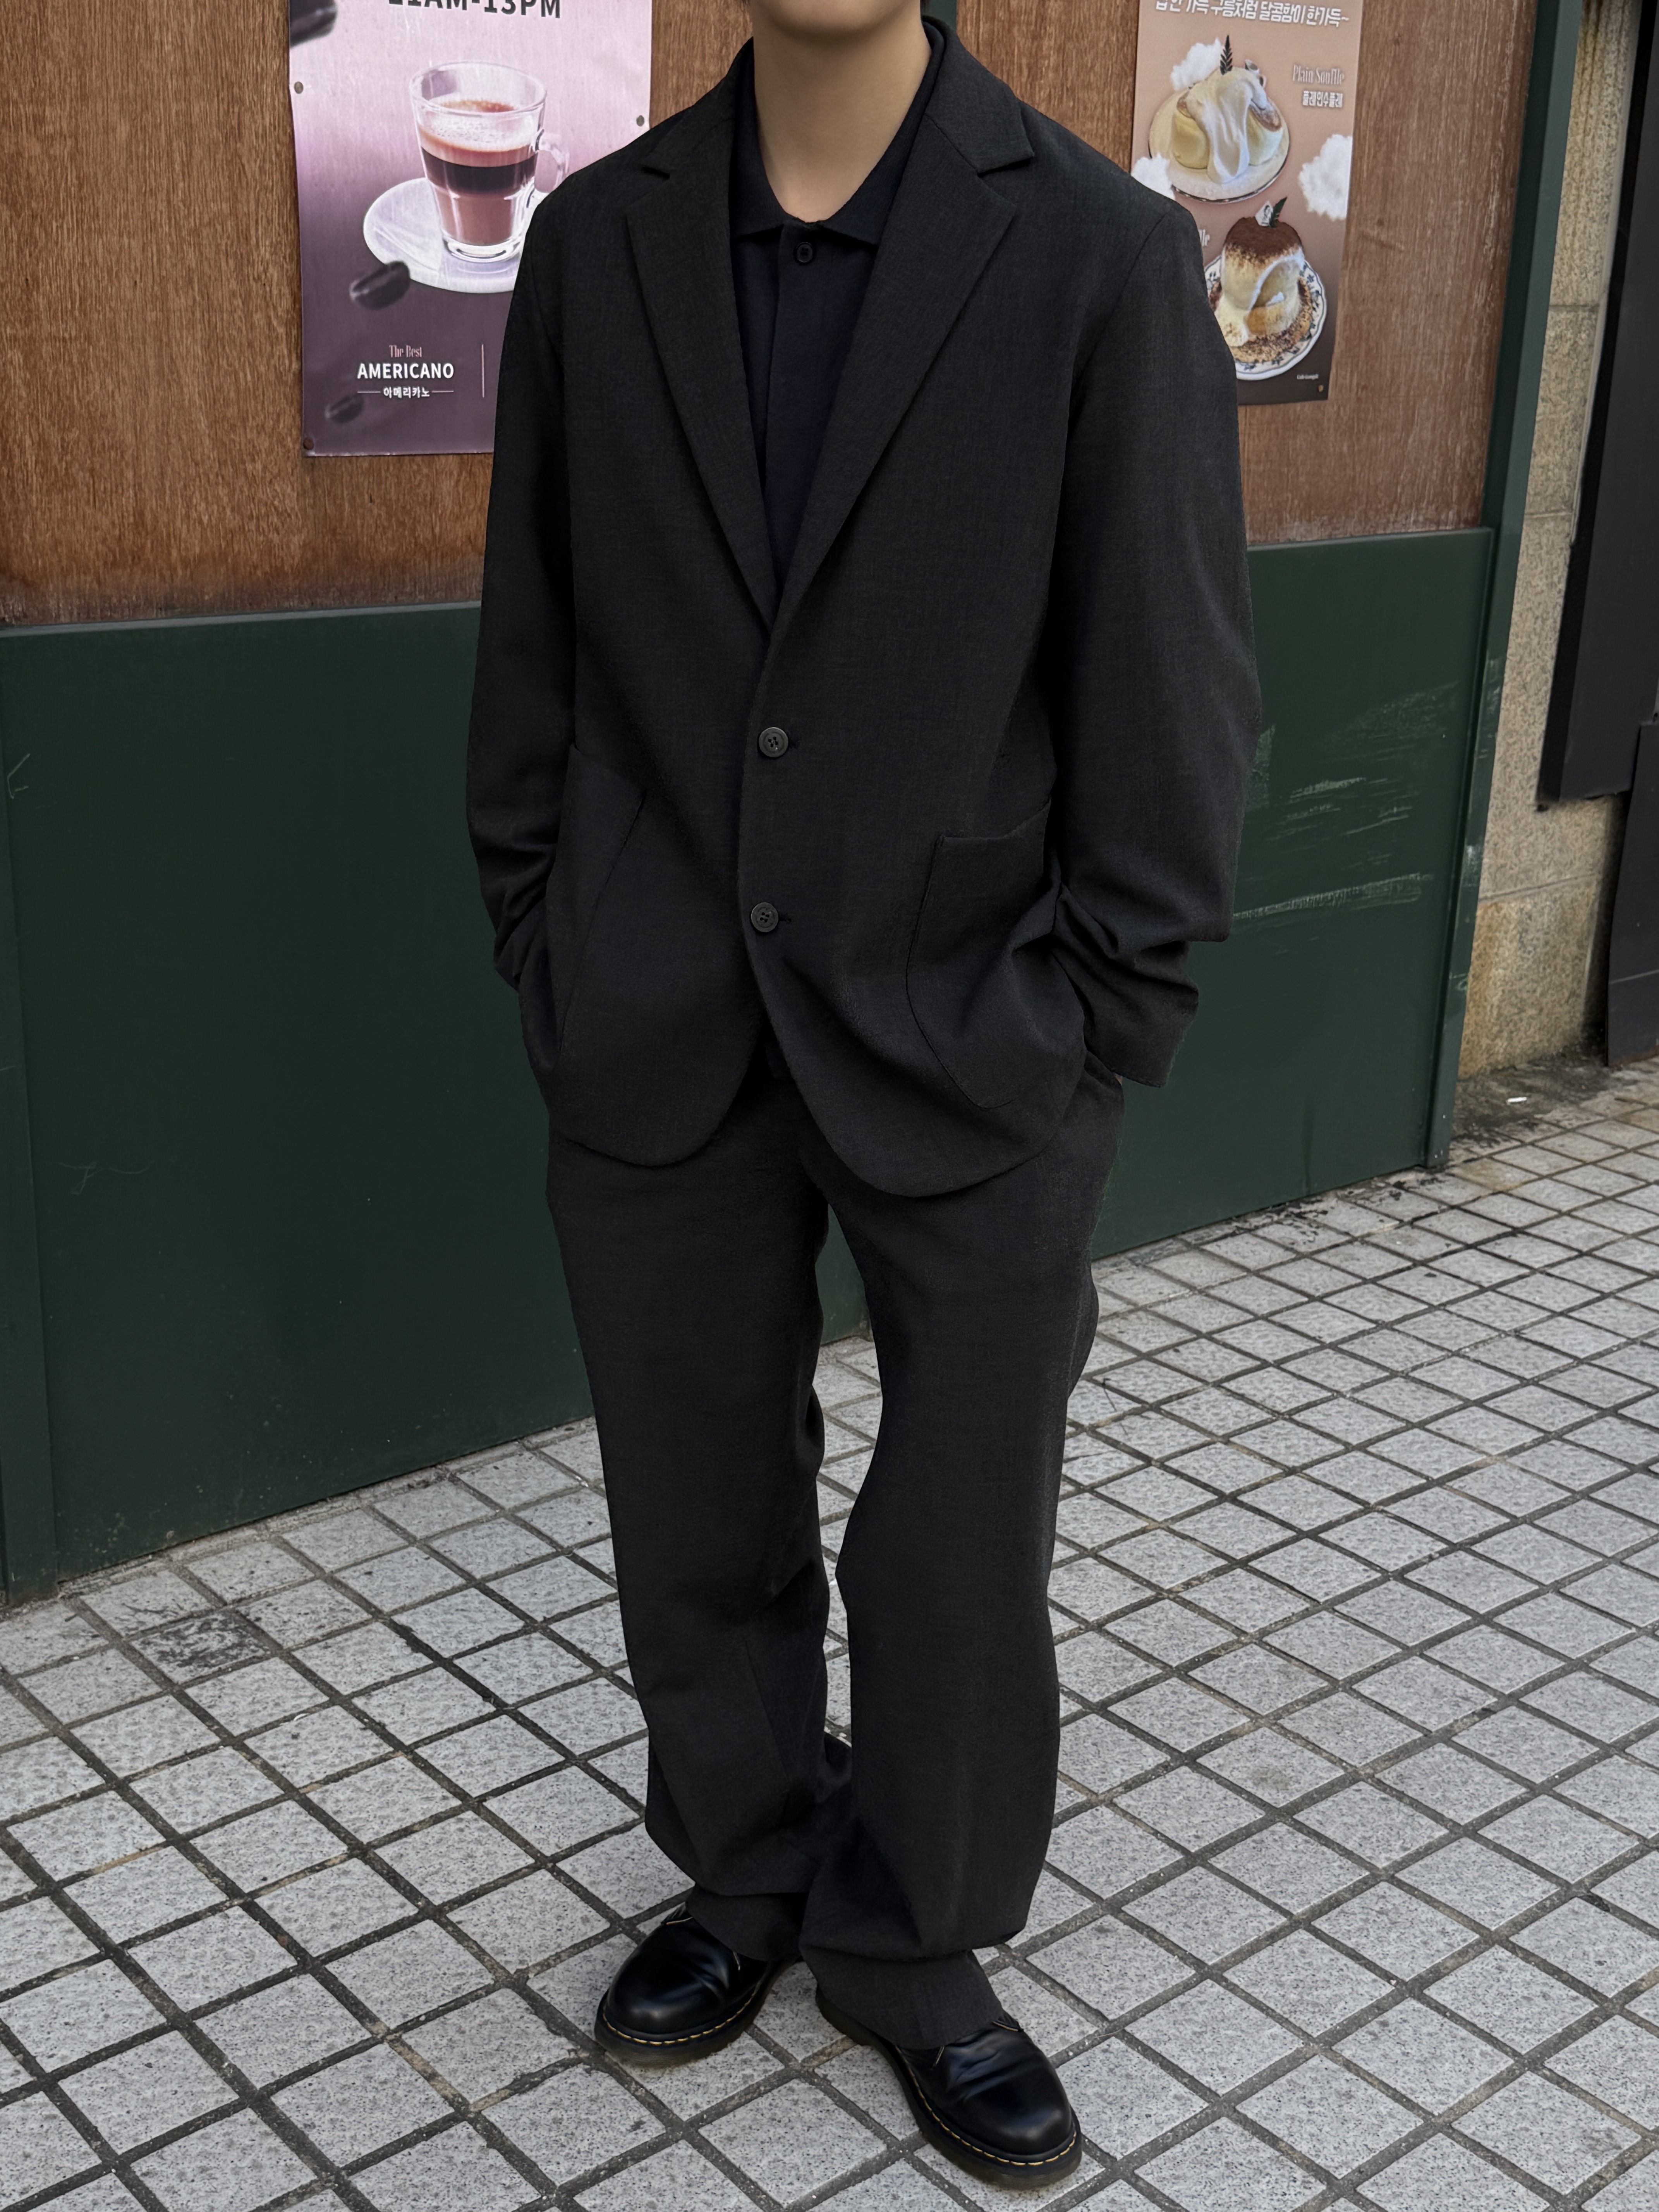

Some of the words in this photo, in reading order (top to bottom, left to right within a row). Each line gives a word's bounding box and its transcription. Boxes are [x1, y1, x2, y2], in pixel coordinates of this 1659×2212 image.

[389, 0, 560, 18] -13PM
[1156, 0, 1180, 12] 안
[1210, 0, 1258, 19] 구름처럼
[1259, 1, 1306, 24] 달콤함이
[1293, 64, 1313, 83] Plain
[389, 345, 404, 357] The
[406, 345, 422, 357] Best
[357, 363, 454, 379] AMERICANO
[383, 386, 430, 398] 아메리카노
